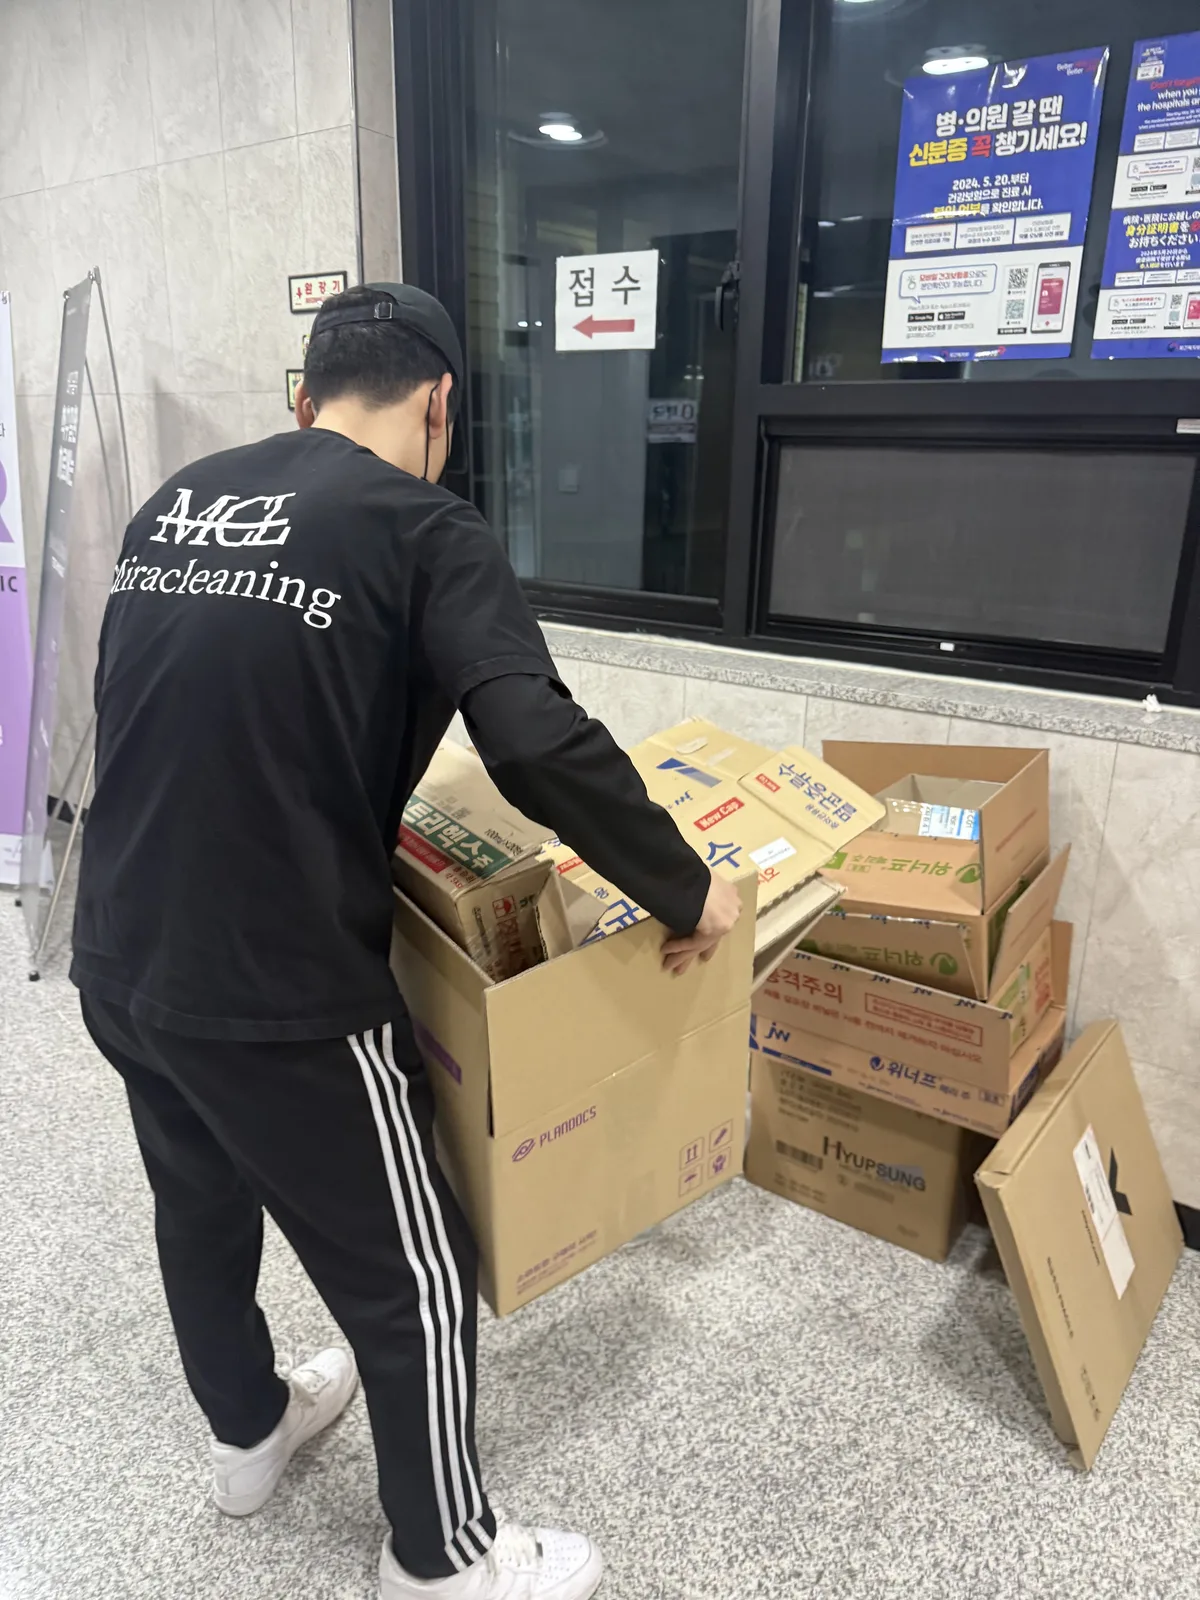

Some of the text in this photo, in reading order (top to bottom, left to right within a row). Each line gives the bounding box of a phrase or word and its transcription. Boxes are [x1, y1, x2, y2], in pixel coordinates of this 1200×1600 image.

[1137, 102, 1151, 113] the
[1152, 97, 1190, 111] hospitals
[1157, 87, 1198, 101] when you
[936, 95, 1063, 137] 병·의원 갈 땐
[909, 121, 1088, 168] 신분증 꼭 챙기세요!
[948, 185, 1032, 204] 건강보험으로 진료 시
[952, 172, 1029, 191] 2024. 5. 20.부터
[991, 198, 1044, 214] 확인합니다.
[110, 555, 342, 629] Miracleaning
[778, 762, 858, 824] 멸균증류수
[699, 800, 740, 830] New Cap
[887, 1061, 937, 1089] 위너프
[539, 1105, 597, 1149] PLANDOCS
[822, 1136, 927, 1192] HYUPSUNG
